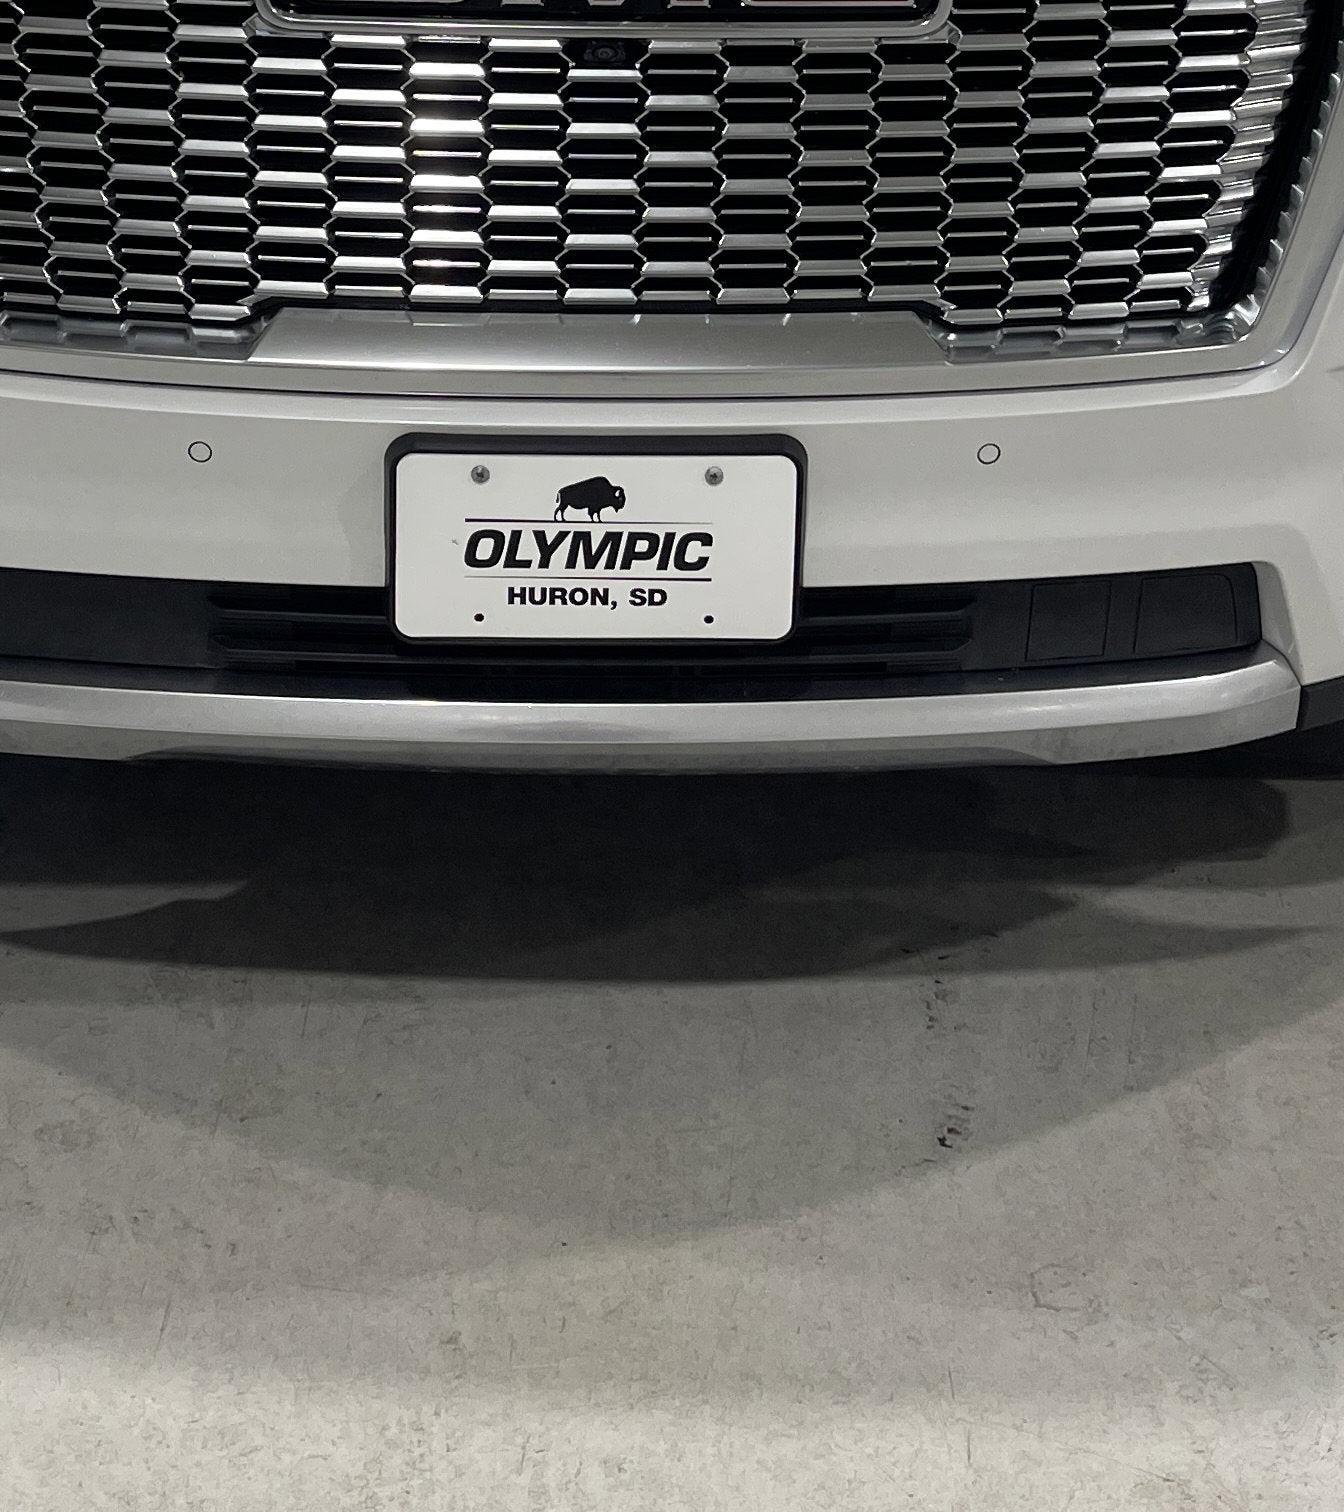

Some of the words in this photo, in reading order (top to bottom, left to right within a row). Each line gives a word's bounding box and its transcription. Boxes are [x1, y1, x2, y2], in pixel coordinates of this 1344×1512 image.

[464, 529, 714, 571] OLYMPIC
[507, 586, 618, 611] HURON,
[629, 588, 668, 608] SD
